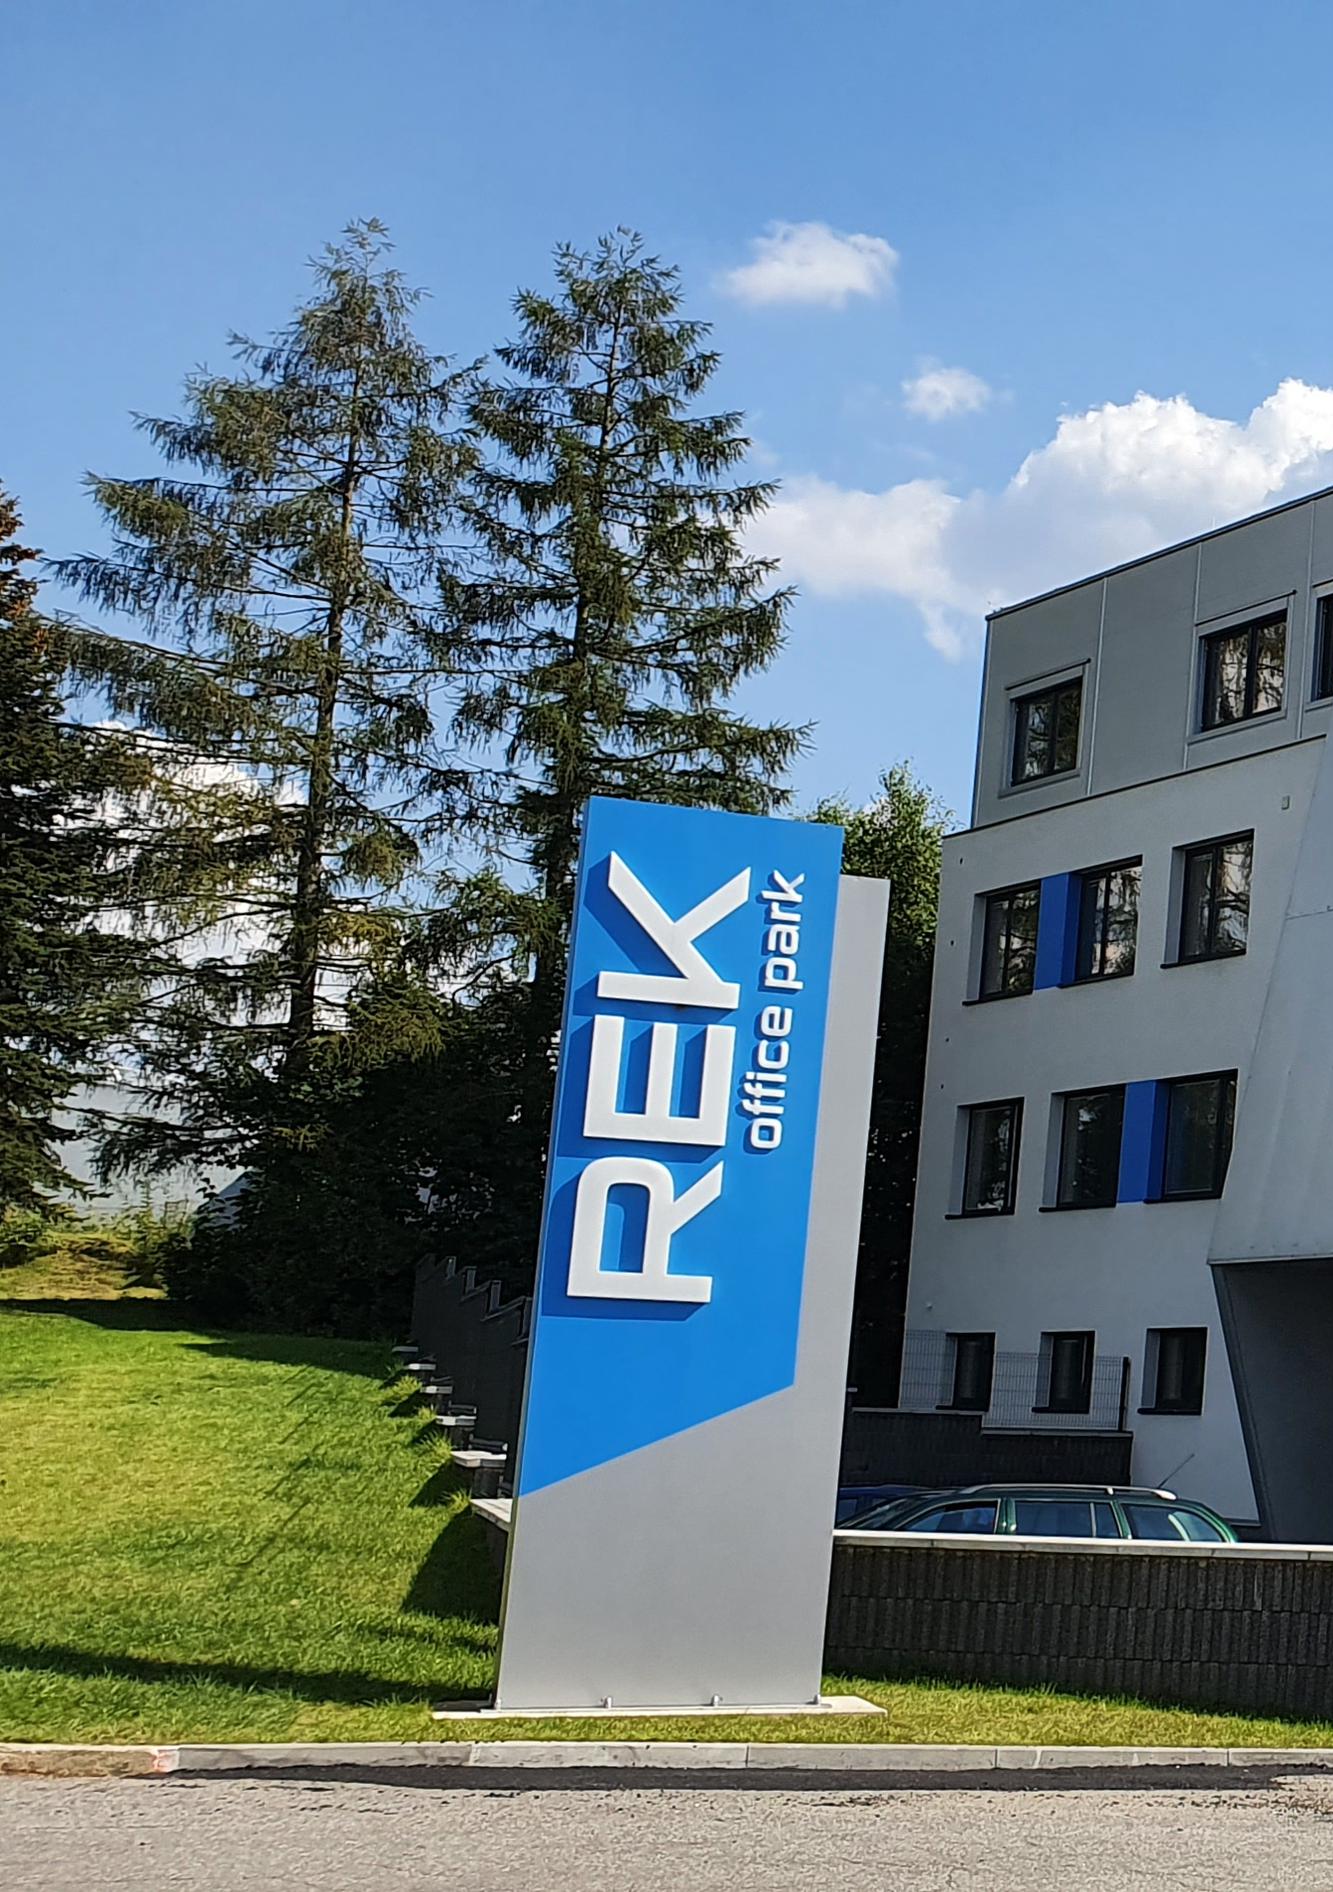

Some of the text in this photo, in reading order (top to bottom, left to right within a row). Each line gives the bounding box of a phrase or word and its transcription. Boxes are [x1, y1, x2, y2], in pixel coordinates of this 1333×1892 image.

[567, 851, 751, 1303] REK
[741, 870, 805, 1150] office park
